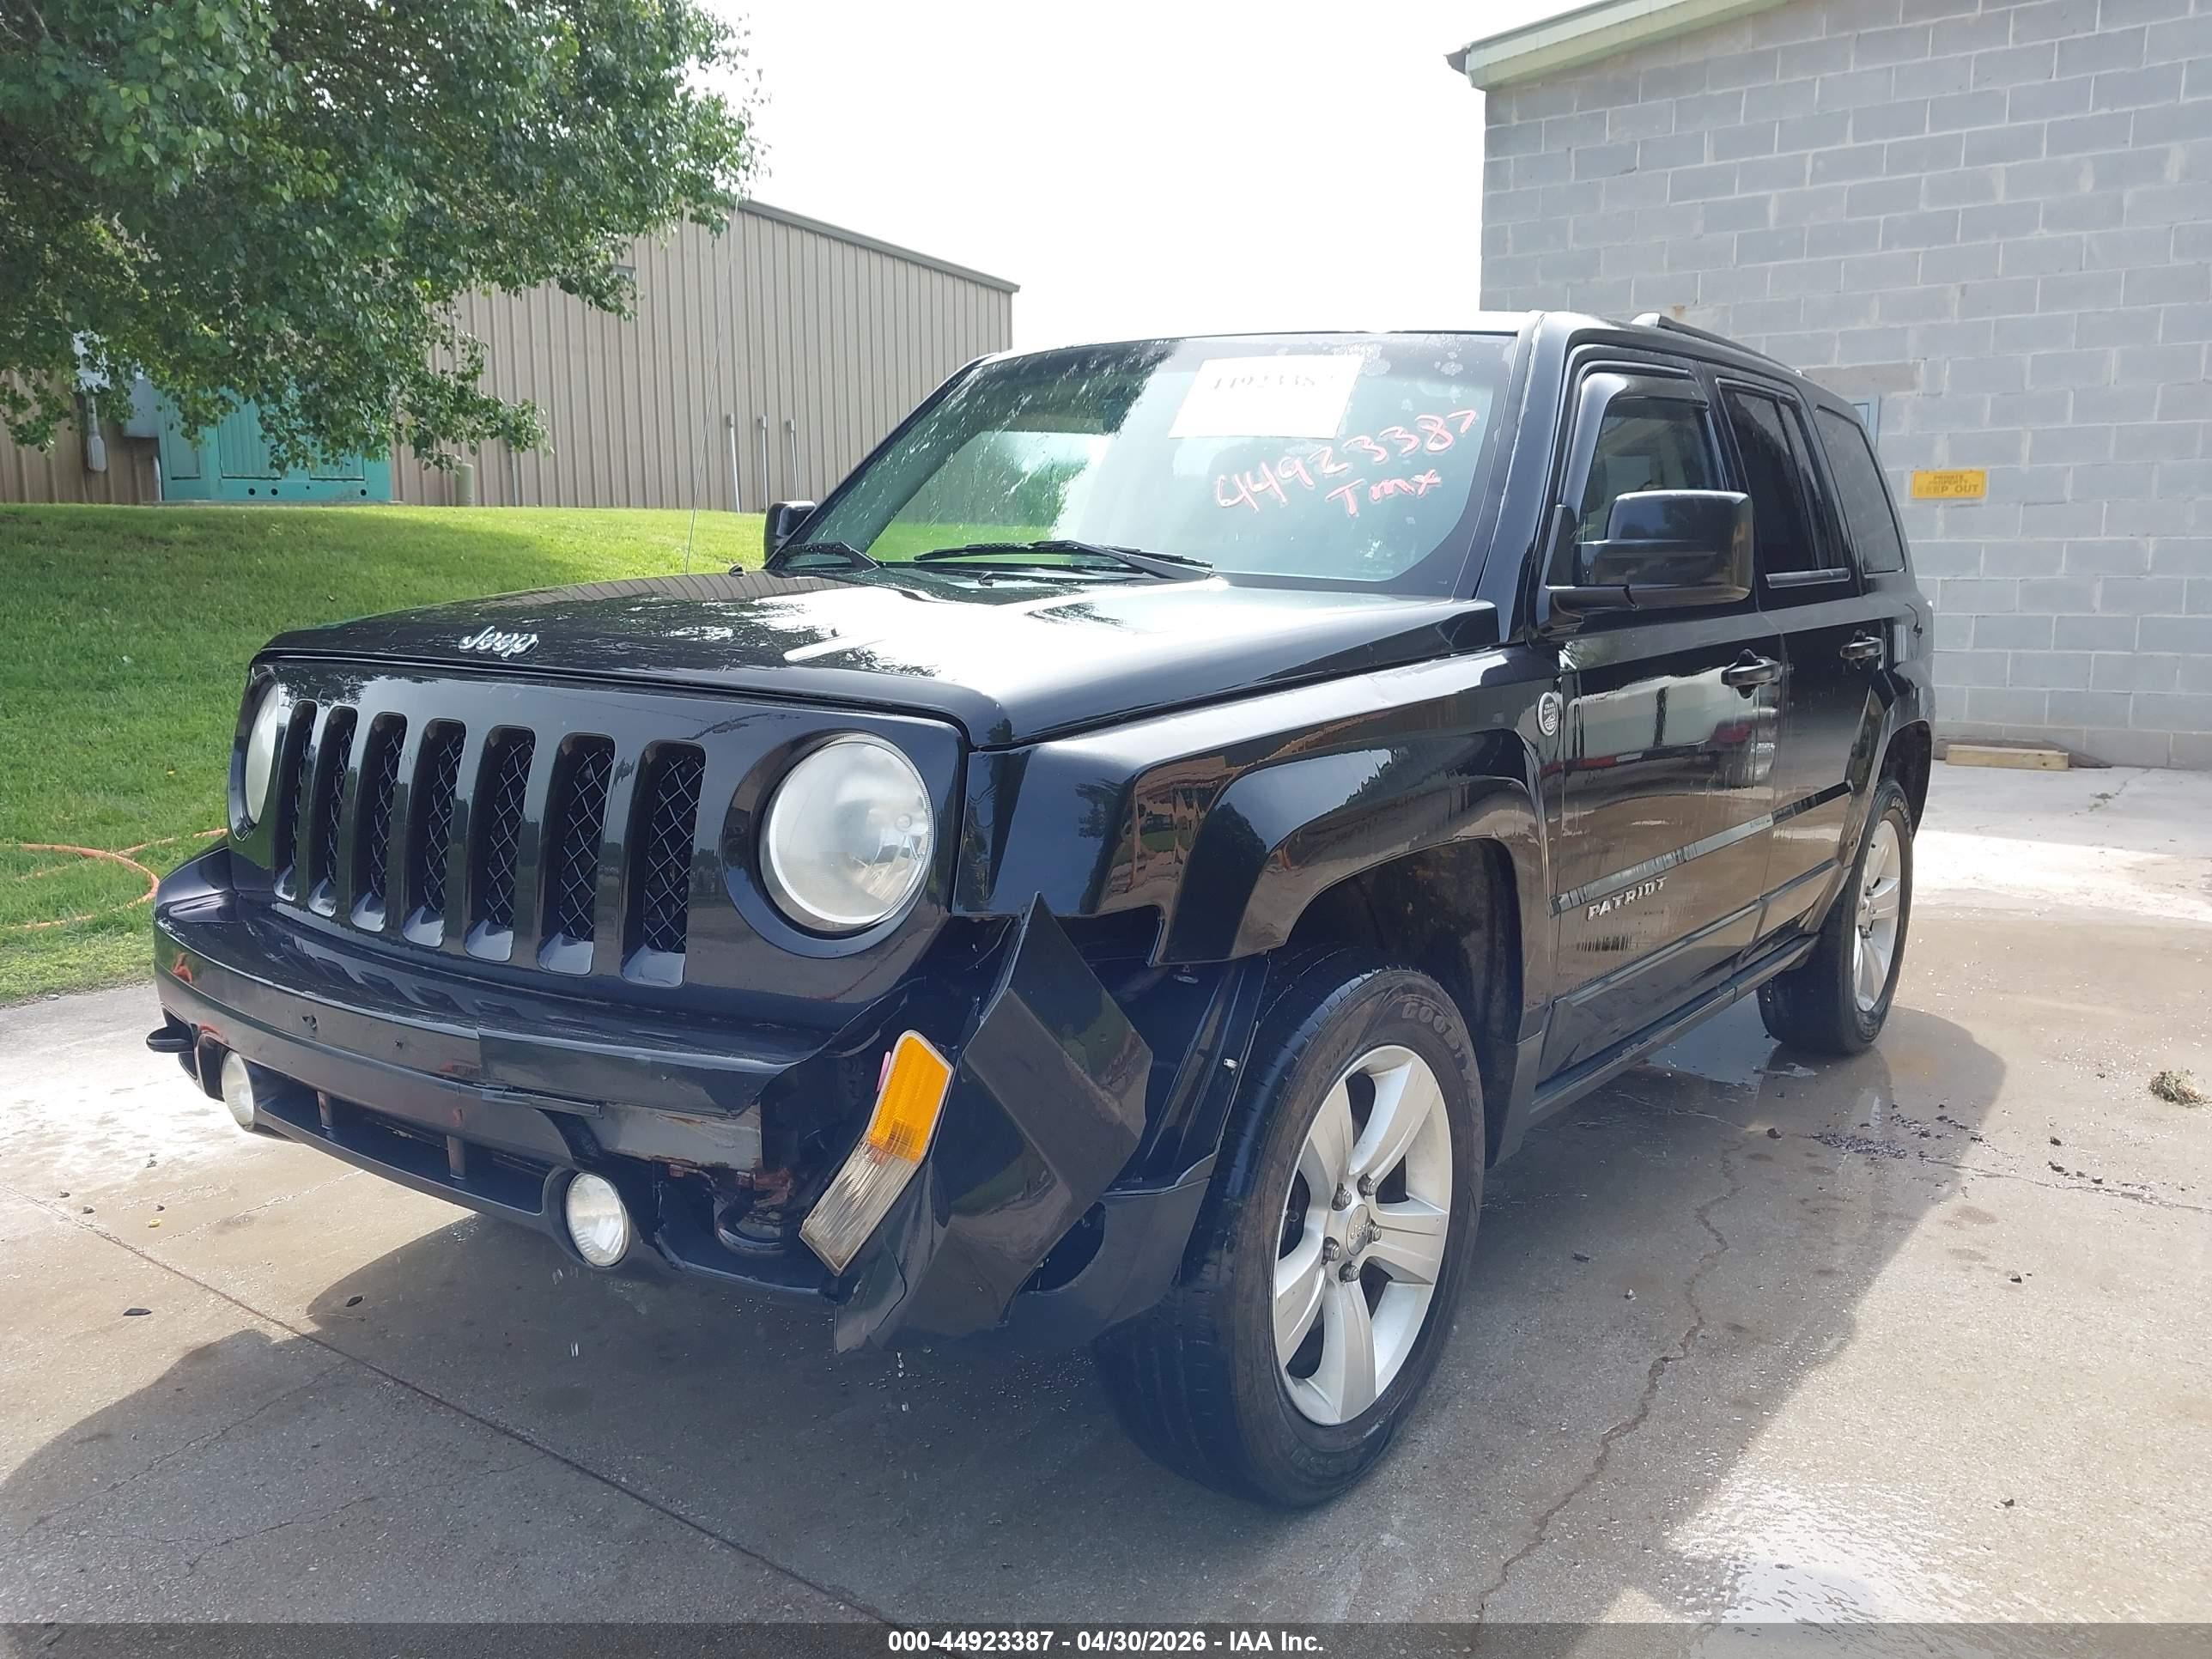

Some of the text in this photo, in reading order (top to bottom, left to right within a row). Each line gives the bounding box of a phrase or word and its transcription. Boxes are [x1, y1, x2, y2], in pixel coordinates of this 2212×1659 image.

[1216, 410, 1477, 514] 44923387
[1954, 483, 1979, 494] OUT
[457, 625, 539, 659] Jeep
[1586, 876, 1668, 921] PATRIOT
